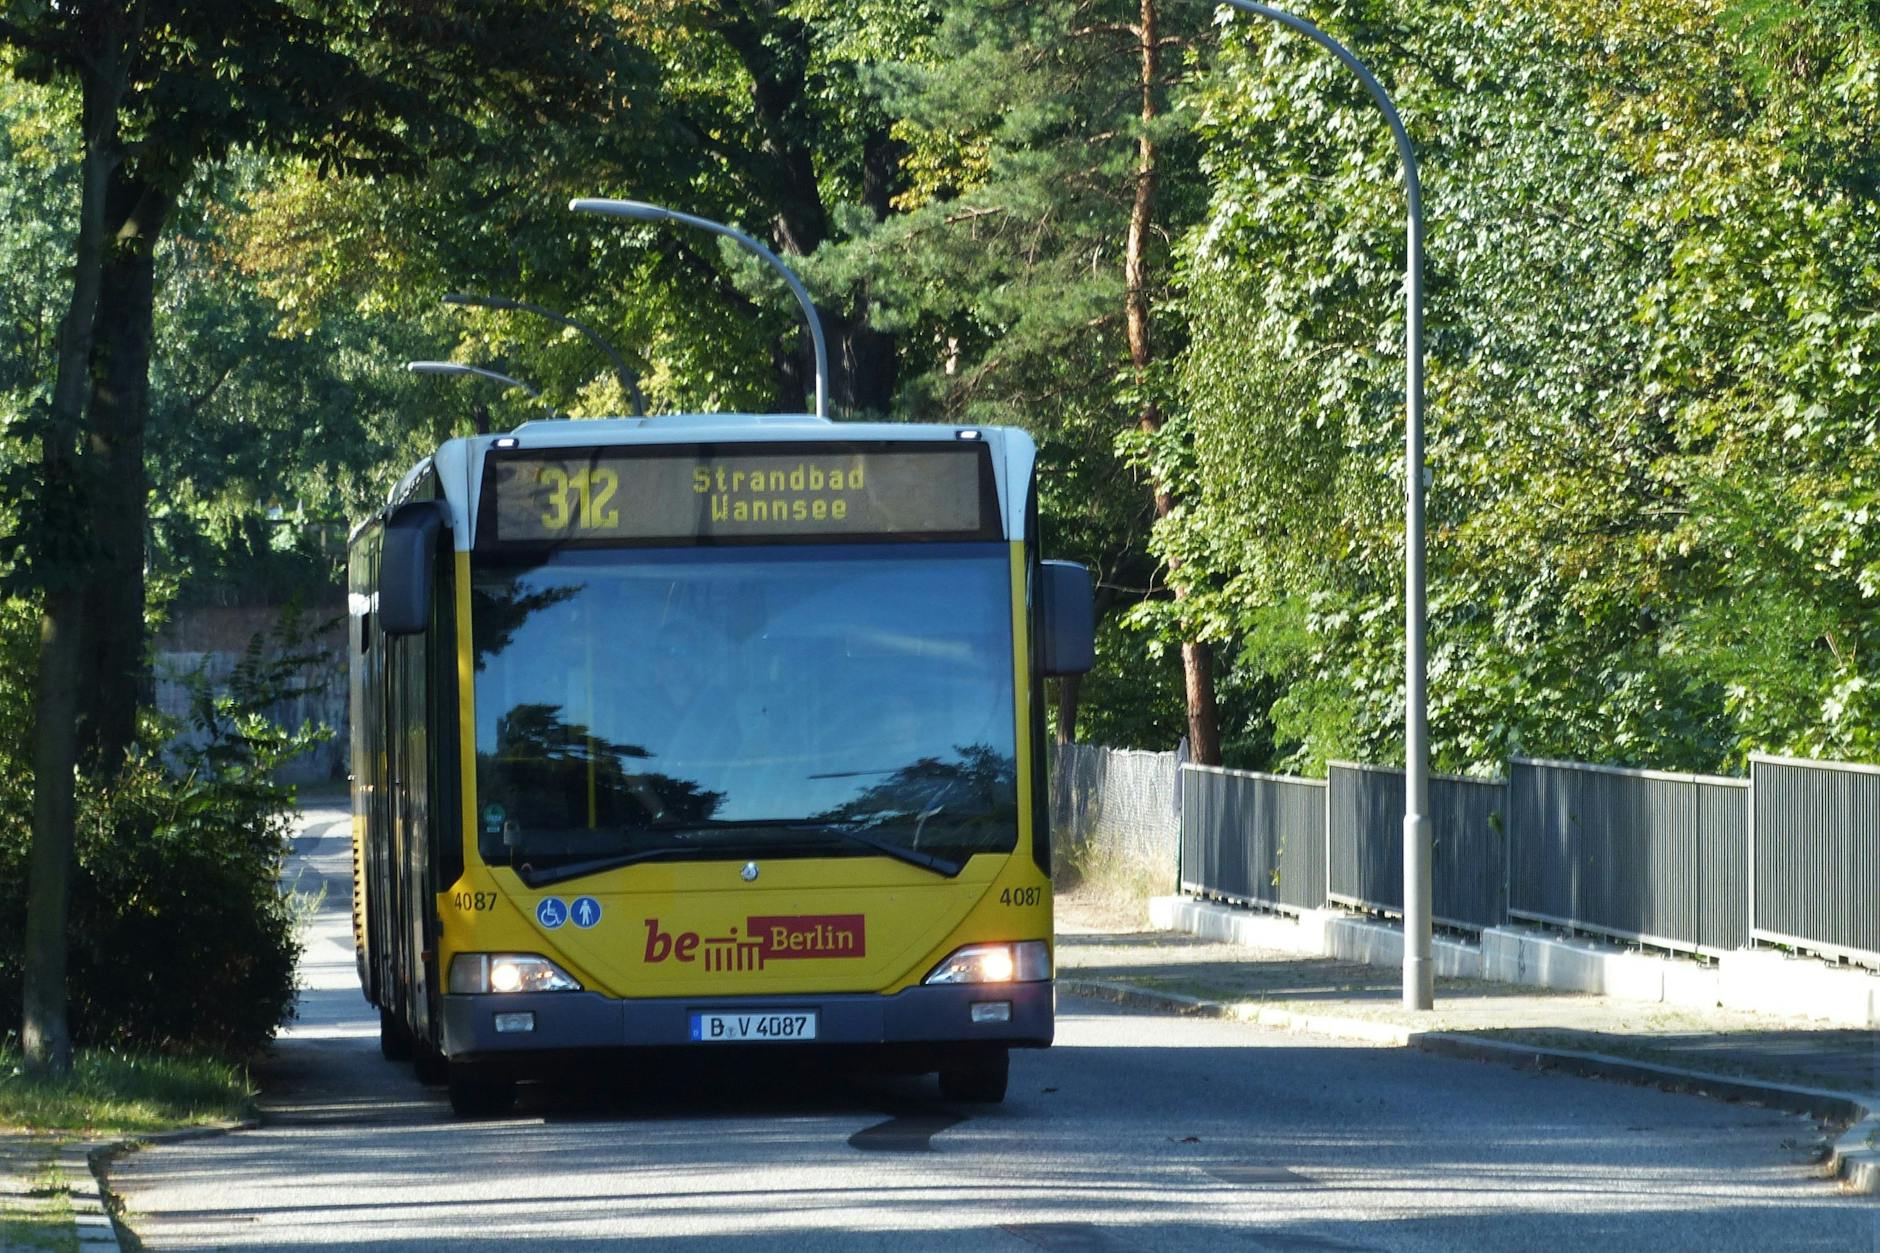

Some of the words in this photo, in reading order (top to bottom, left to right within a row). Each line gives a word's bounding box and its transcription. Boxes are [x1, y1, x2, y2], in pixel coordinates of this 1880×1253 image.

[693, 464, 865, 493] Strandbad
[540, 466, 619, 530] 312
[711, 495, 848, 522] Wannsee
[454, 892, 498, 912] 4087
[1000, 887, 1041, 907] 4087
[643, 919, 700, 963] be
[770, 923, 854, 951] Berlin
[756, 1017, 807, 1037] 4087
